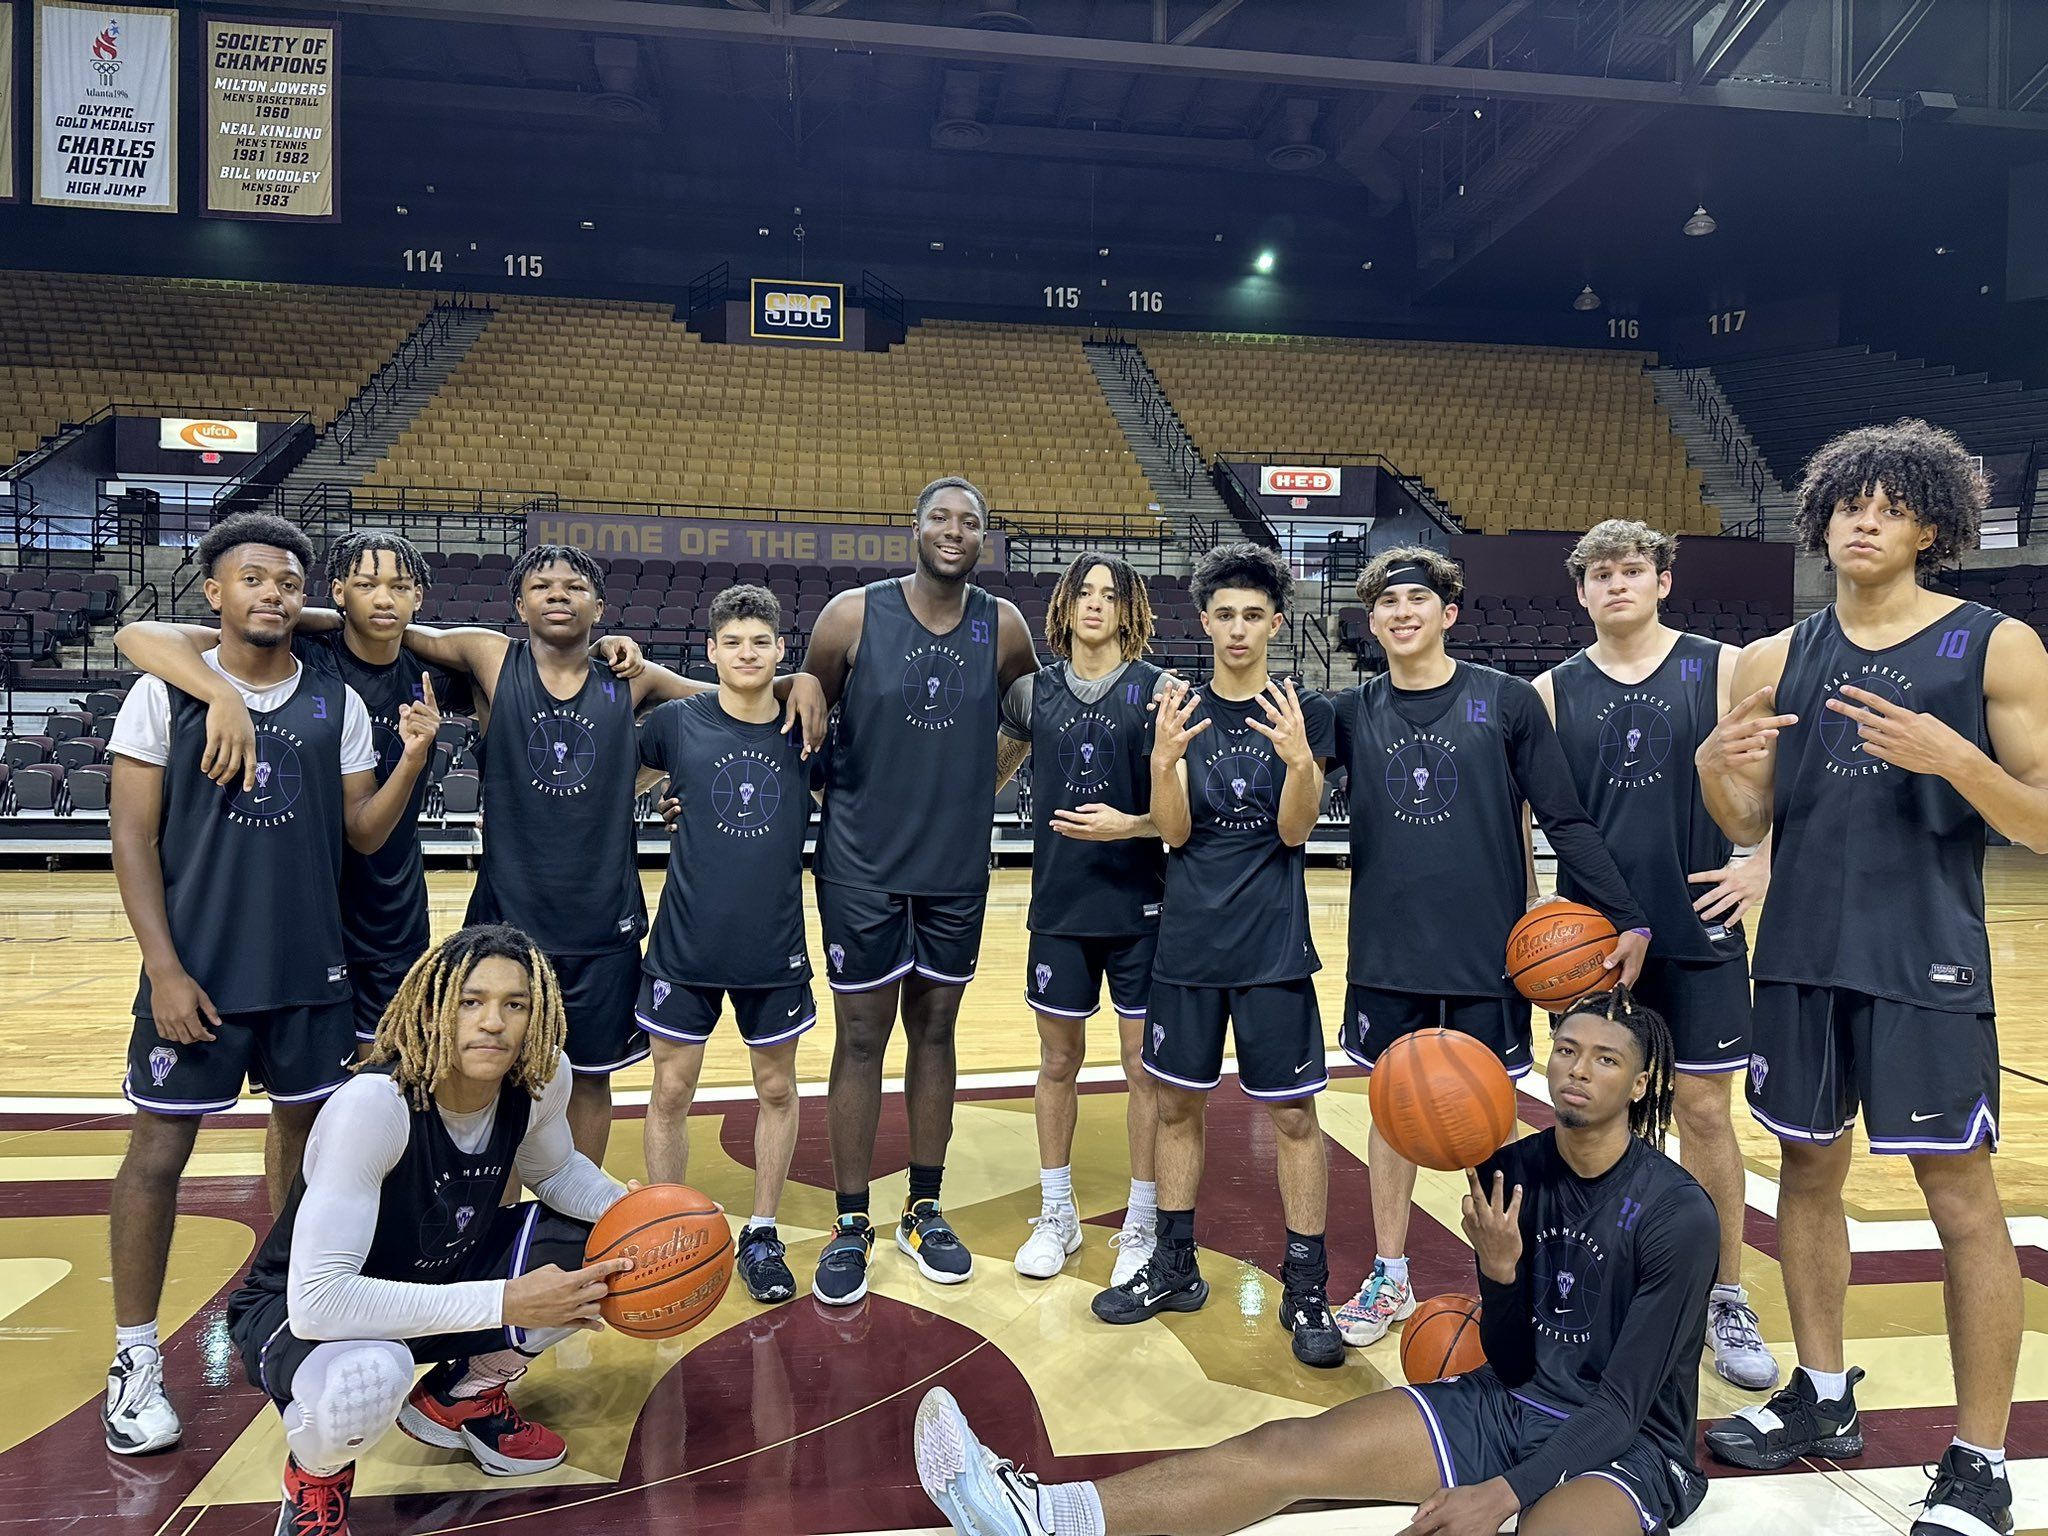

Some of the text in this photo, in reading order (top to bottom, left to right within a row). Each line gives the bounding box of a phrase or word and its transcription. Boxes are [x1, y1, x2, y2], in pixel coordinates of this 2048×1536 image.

[216, 32, 327, 55] SOCIETY OF
[214, 52, 327, 75] CHAMPIONS
[214, 77, 327, 96] MILTON JOWERS
[223, 92, 319, 107] MEN'S BASKETBALL
[77, 104, 134, 118] OLYMPIC
[255, 105, 290, 119] 1960
[55, 115, 155, 133] GOLD MEDALIST
[219, 122, 323, 140] NEAL KINLUND
[57, 134, 156, 158] CHARLES
[236, 138, 308, 150] MEN'S TENNIS
[65, 155, 148, 178] AUSTIN
[232, 148, 310, 164] 1981 1982
[220, 166, 321, 184] BILL WOODLEY
[66, 180, 147, 198] HIGH JUMP
[241, 182, 301, 194] MEN'S GOLF
[254, 194, 291, 208] 1983
[402, 250, 444, 273] 114
[503, 254, 544, 278] 115
[1043, 286, 1080, 309] 115
[1128, 291, 1164, 313] 116
[764, 291, 832, 329] SBC
[1607, 318, 1640, 339] 116
[1707, 310, 1747, 335] 117
[202, 424, 230, 437] ufcu
[539, 520, 663, 554] HOME
[679, 527, 730, 556] OF
[746, 530, 816, 560] THE
[970, 619, 990, 645] 53
[904, 647, 924, 663] SAN
[1935, 629, 1971, 659] 10
[1680, 658, 1702, 683] 14
[1824, 664, 1913, 693] SAN MARCOS
[601, 681, 617, 703] 4
[1126, 683, 1141, 705] 11
[311, 695, 328, 719] 3
[1465, 699, 1487, 723] 12
[1596, 693, 1671, 721] SAN MARCOS
[1386, 733, 1457, 755] SAN MARCOS
[714, 750, 781, 773] SAN MARCOS
[1205, 749, 1224, 766] SAN
[228, 811, 295, 828] RATTLERS
[1393, 810, 1451, 826] RATTLERS
[716, 821, 771, 838] RATTLERS
[1536, 1226, 1605, 1261] SAN MARCOS
